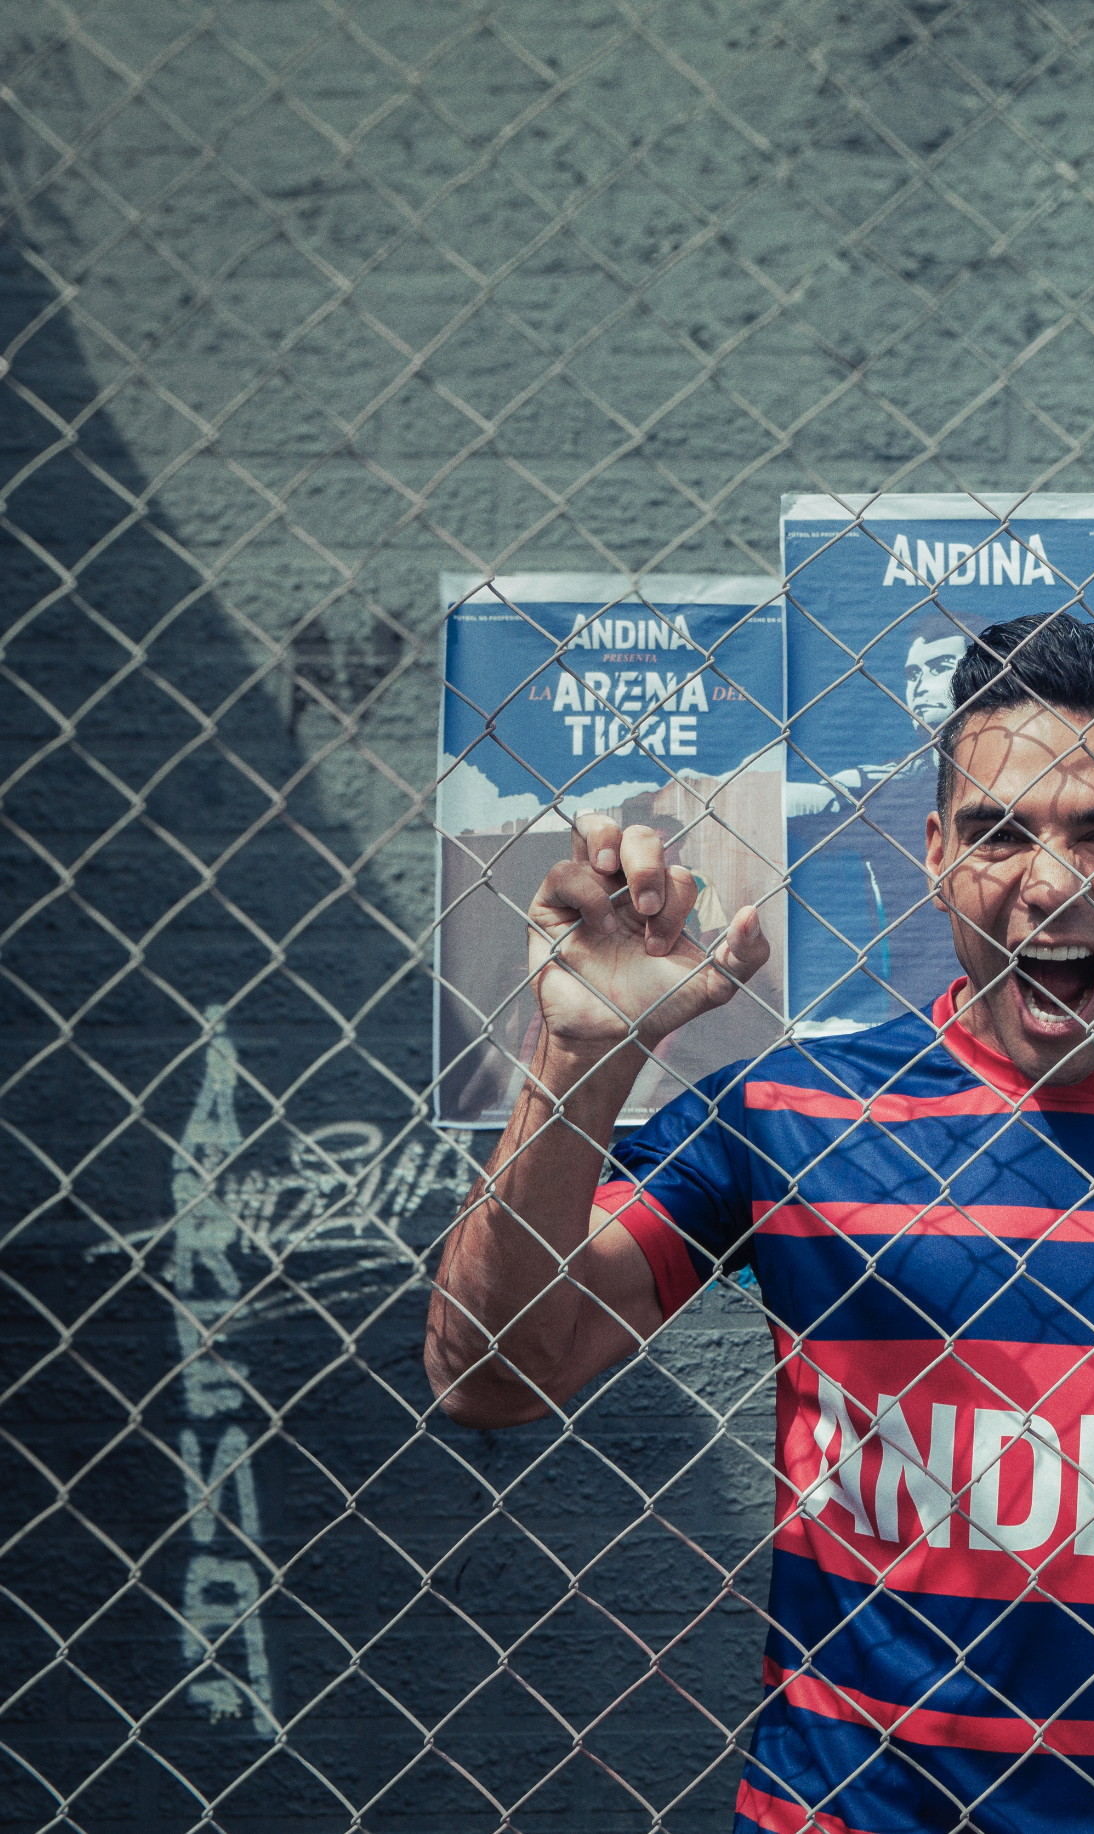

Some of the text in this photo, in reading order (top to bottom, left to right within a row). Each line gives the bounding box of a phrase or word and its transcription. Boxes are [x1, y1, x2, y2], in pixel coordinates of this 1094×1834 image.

[882, 533, 1055, 587] ANDINA
[567, 613, 693, 651] ANDINA
[602, 653, 657, 663] PRESENTA
[528, 671, 747, 712] LA ARENA DEL
